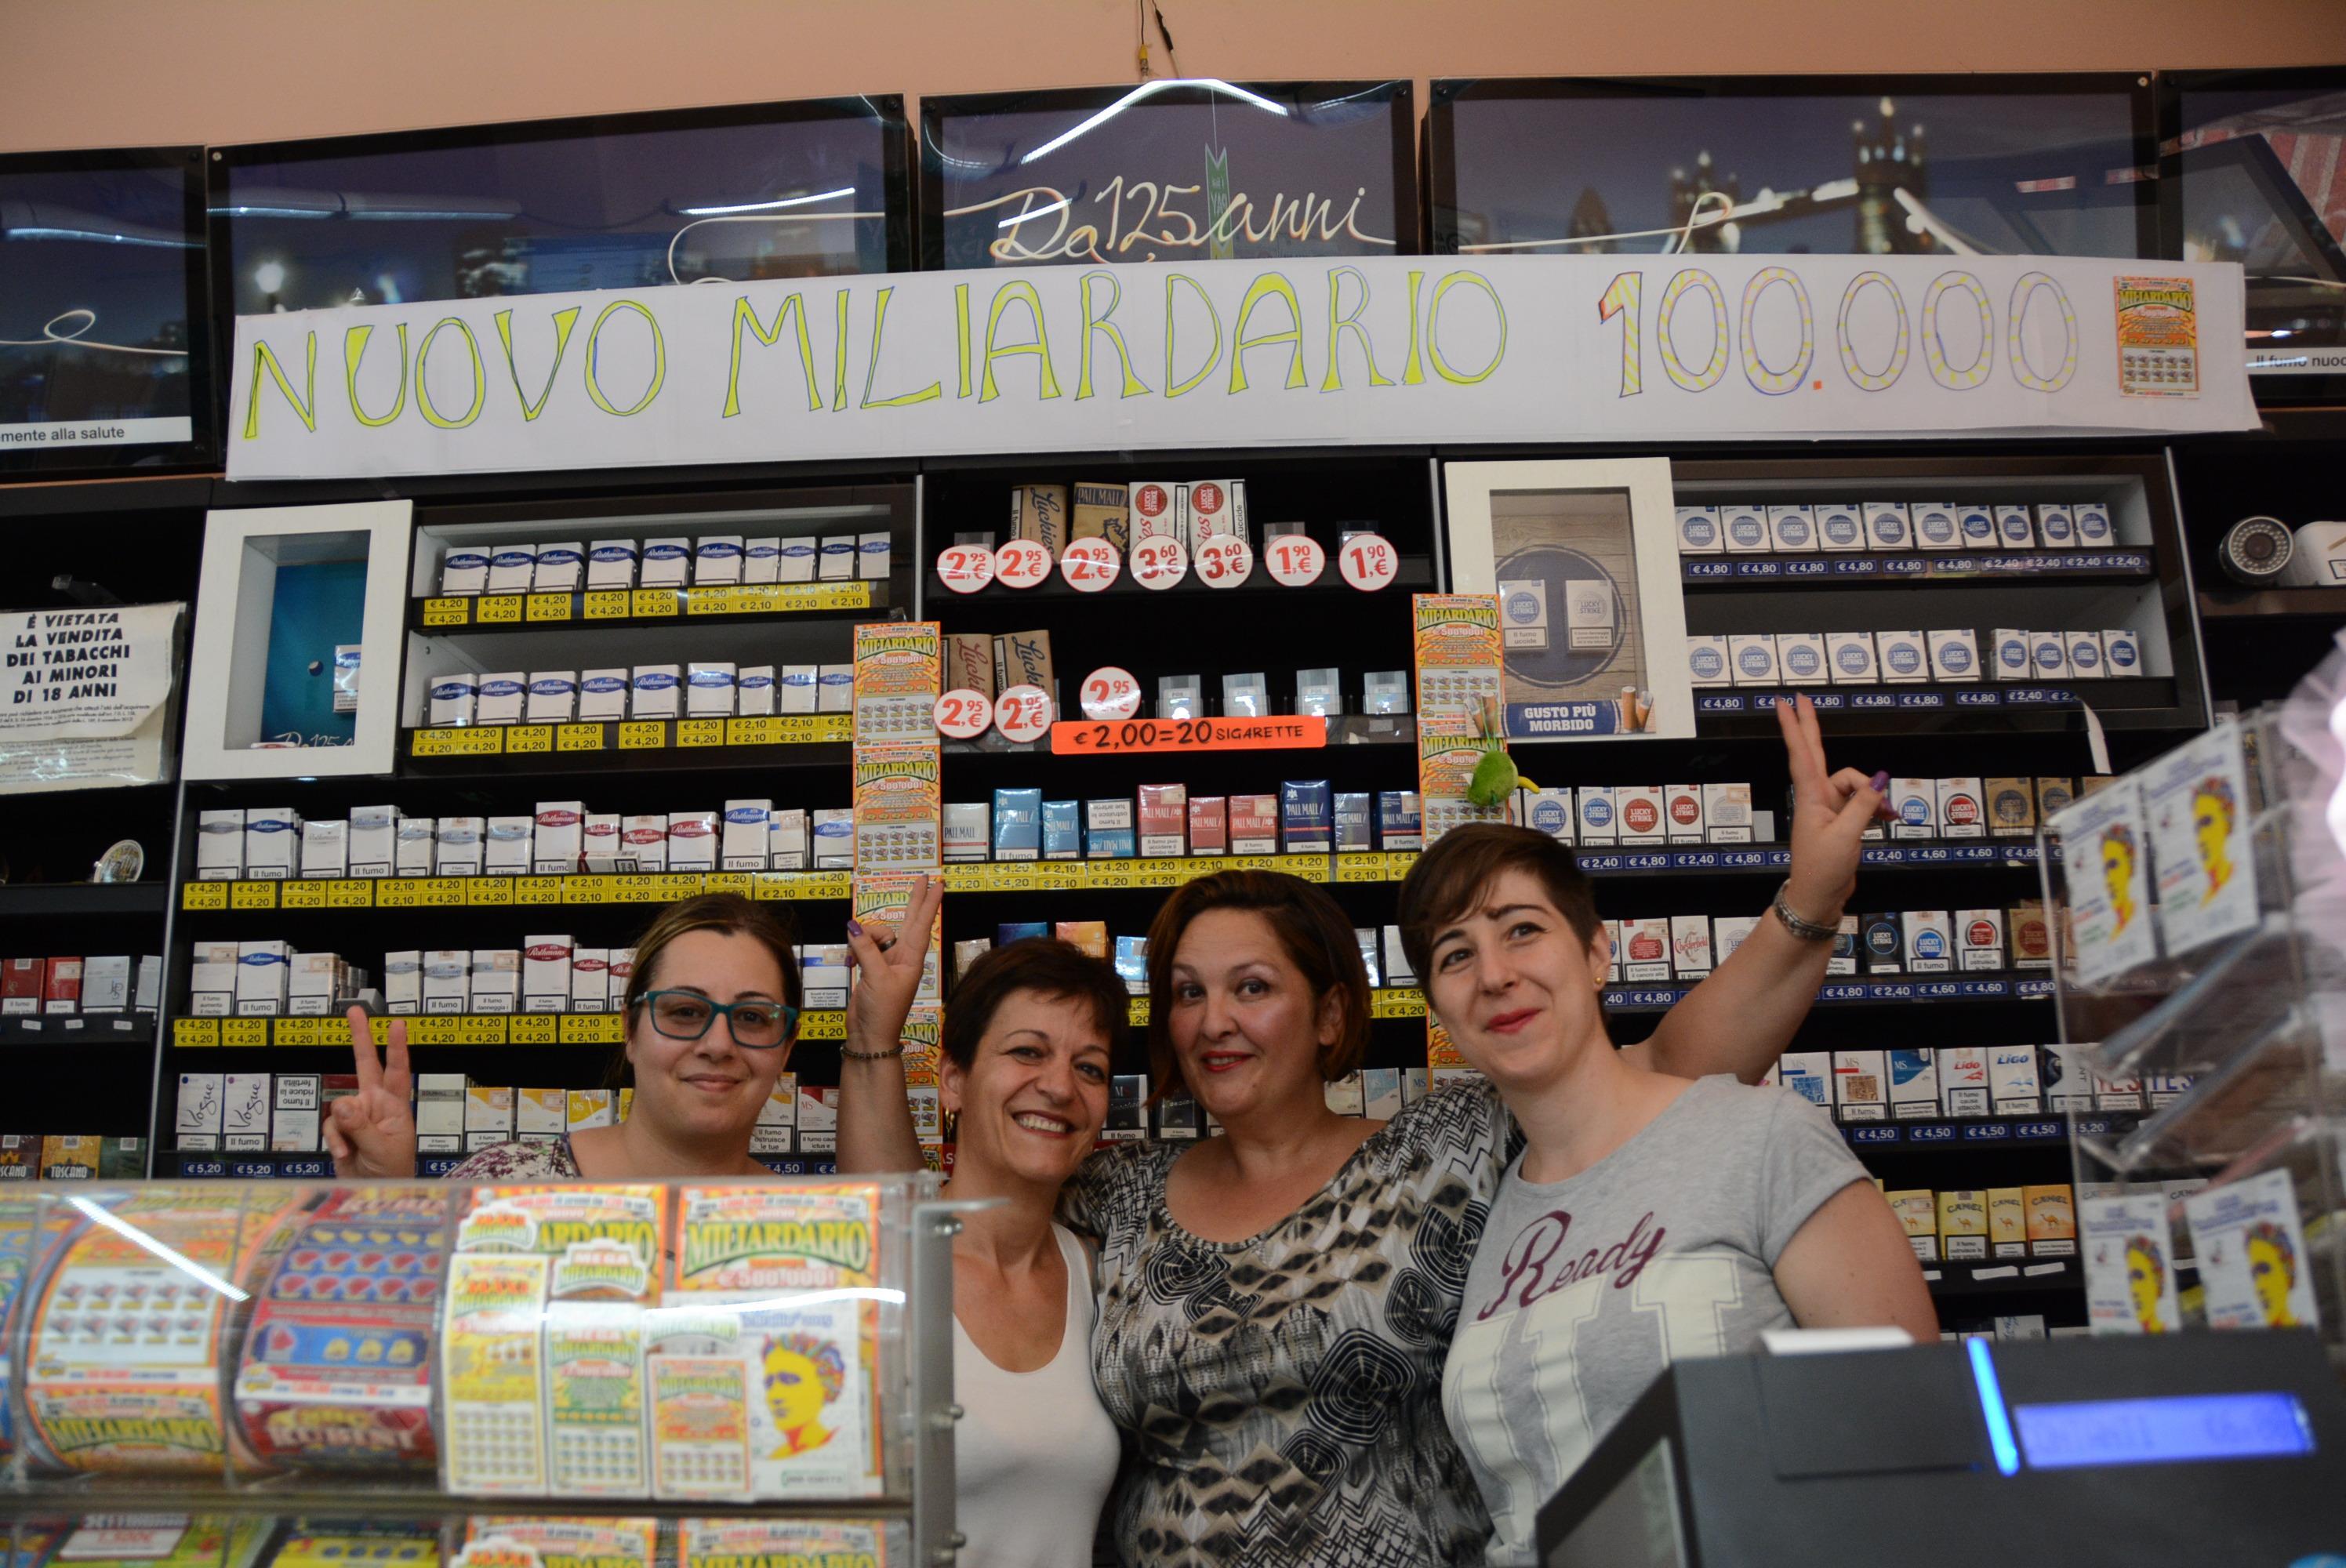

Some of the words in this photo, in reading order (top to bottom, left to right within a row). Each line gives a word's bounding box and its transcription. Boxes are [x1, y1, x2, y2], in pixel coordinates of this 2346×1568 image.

[1095, 176, 1200, 252] 125
[1215, 187, 1396, 245] anni
[245, 299, 666, 439] NUOVO
[722, 265, 1507, 418] MILIARDARIO
[1598, 267, 2079, 397] 100.000
[51, 428, 76, 441] alla
[81, 426, 125, 439] salute
[1077, 487, 1097, 505] PALL
[1099, 488, 1120, 506] MALL
[45, 613, 118, 627] VIETATA
[1418, 608, 1498, 631] MILIARDARIO
[16, 634, 38, 648] LA
[47, 628, 123, 645] VENDITA
[6, 652, 34, 667] DEI
[42, 644, 129, 664] TABACCHI
[858, 636, 937, 661] MILIARDARIO
[22, 670, 41, 684] AI
[49, 664, 117, 682] MINORI
[13, 690, 32, 703] DI
[42, 688, 61, 702] 18
[68, 683, 117, 699] ANNI
[1524, 706, 1568, 720] GUSTO
[1572, 703, 1596, 719] PIÙ
[1529, 718, 1594, 732] MORBIDO
[1073, 731, 1088, 745] €
[1216, 725, 1303, 741] SIGARETTE
[856, 760, 939, 787] MILIARDARIO
[539, 812, 576, 823] Rothmans
[1287, 804, 1301, 815] PALL
[1302, 804, 1319, 815] MALL
[944, 827, 957, 839] PALL
[959, 826, 975, 838] MALL
[1233, 819, 1246, 829] PALL
[1247, 818, 1261, 828] MALL
[1845, 1058, 1859, 1067] MS
[180, 1078, 217, 1127] Vogue
[227, 1079, 264, 1127] Vogue
[801, 1102, 813, 1110] MS
[51, 1167, 87, 1178] TOSCANO
[1947, 1203, 1983, 1213] CAMEL
[2032, 1196, 2068, 1205] CAMEL
[684, 1221, 868, 1277] MILIARDARIO
[1478, 1210, 1665, 1320] Ready
